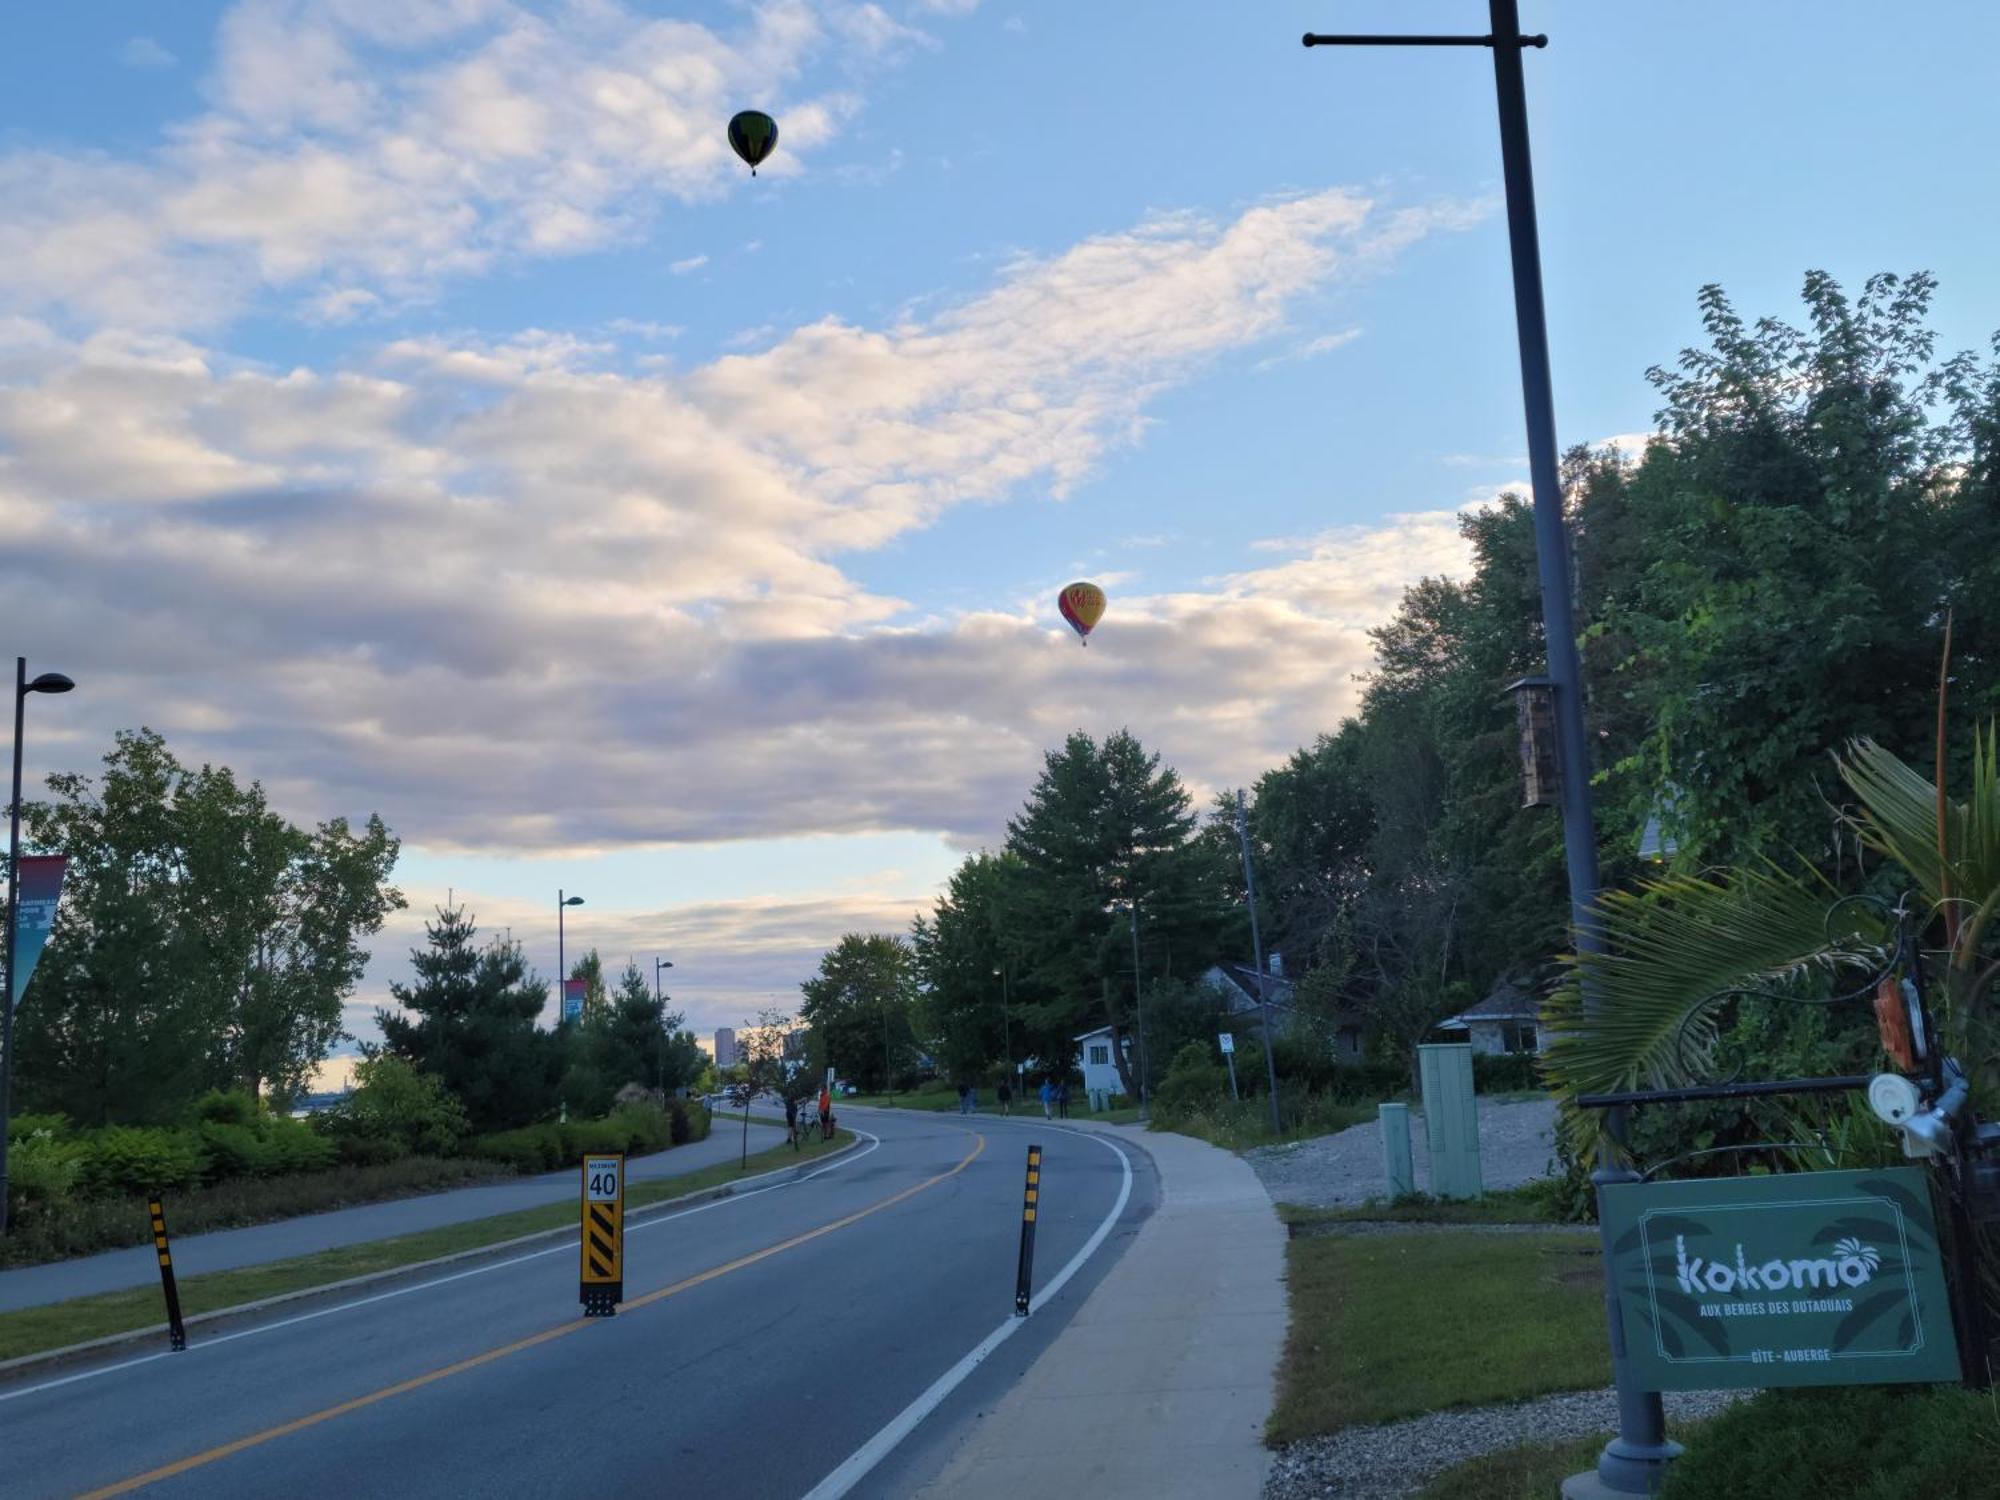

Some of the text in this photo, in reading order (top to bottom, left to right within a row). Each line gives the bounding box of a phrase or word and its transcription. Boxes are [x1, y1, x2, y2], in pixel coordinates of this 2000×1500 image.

[590, 1173, 616, 1196] 40
[1675, 1234, 1873, 1294] kokomo
[1700, 1299, 1853, 1317] AUX BERGES DES OUTAOUAIS
[1784, 1348, 1831, 1363] AUBERGE
